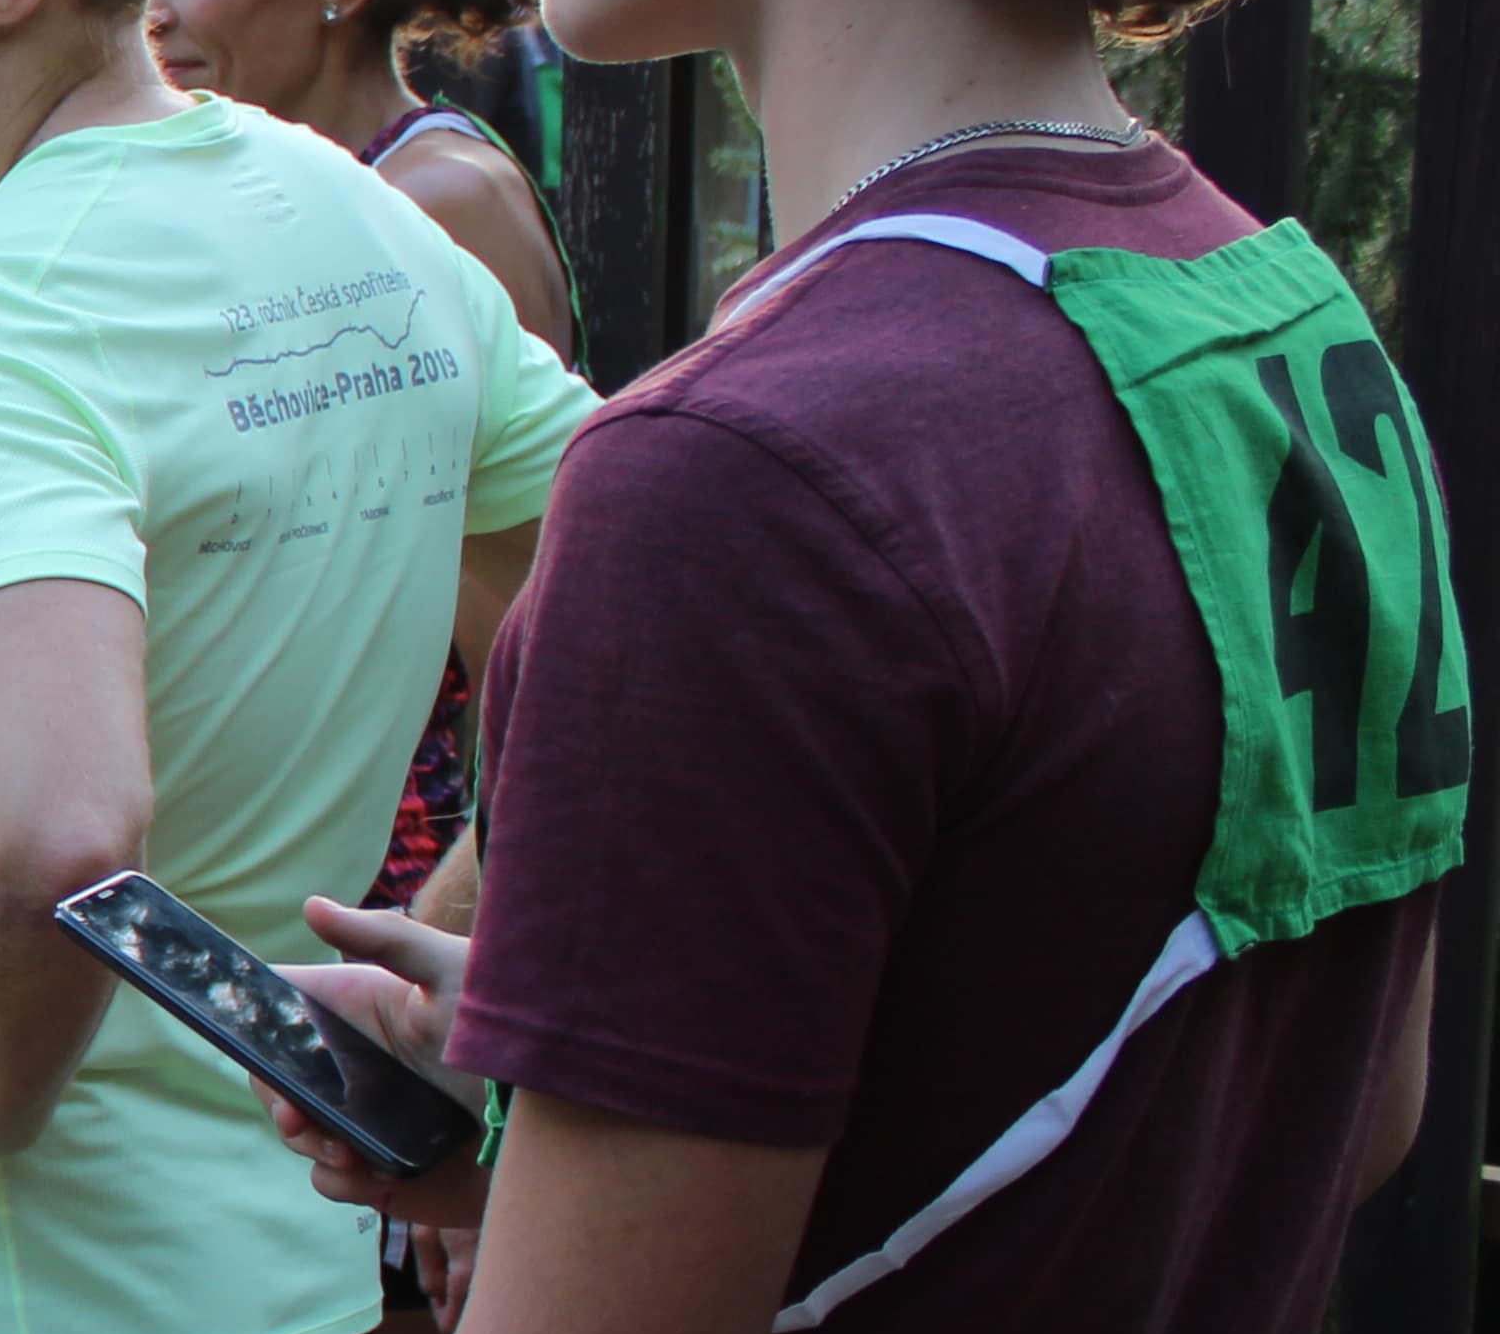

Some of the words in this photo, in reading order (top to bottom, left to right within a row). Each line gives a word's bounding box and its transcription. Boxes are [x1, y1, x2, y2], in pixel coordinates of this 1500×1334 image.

[220, 304, 259, 334] 123.
[257, 293, 299, 324] ročník
[297, 282, 342, 317] Česká
[227, 362, 403, 433] Běchovice-Praha
[407, 347, 461, 388] 2019
[1255, 338, 1473, 815] 42
